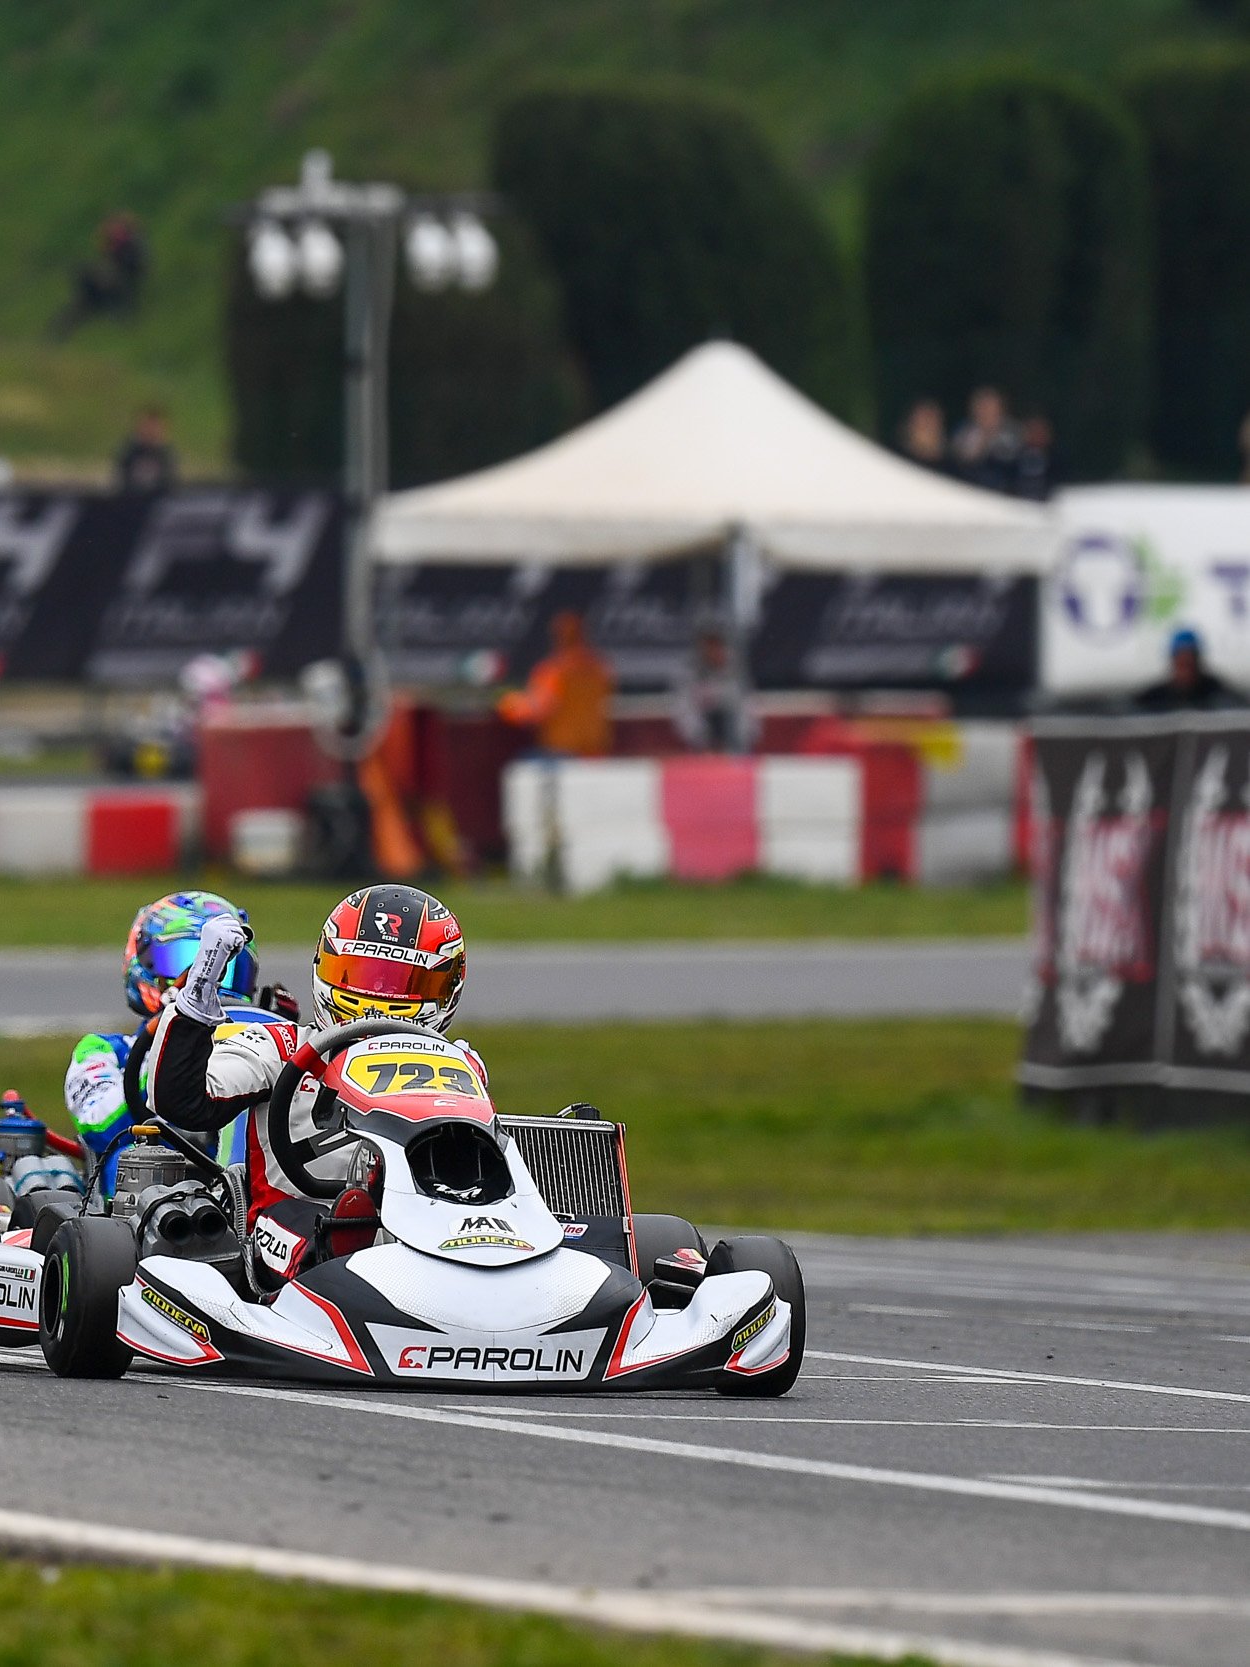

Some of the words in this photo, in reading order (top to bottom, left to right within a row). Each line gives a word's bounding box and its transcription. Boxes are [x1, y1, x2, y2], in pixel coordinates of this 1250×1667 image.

[125, 495, 329, 594] F4
[352, 942, 429, 965] PAROLIN
[379, 1042, 445, 1052] PAROLIN
[367, 1063, 478, 1095] 723
[564, 1224, 583, 1234] ine
[143, 1288, 208, 1337] MODENA
[427, 1346, 584, 1372] PAROLIN
